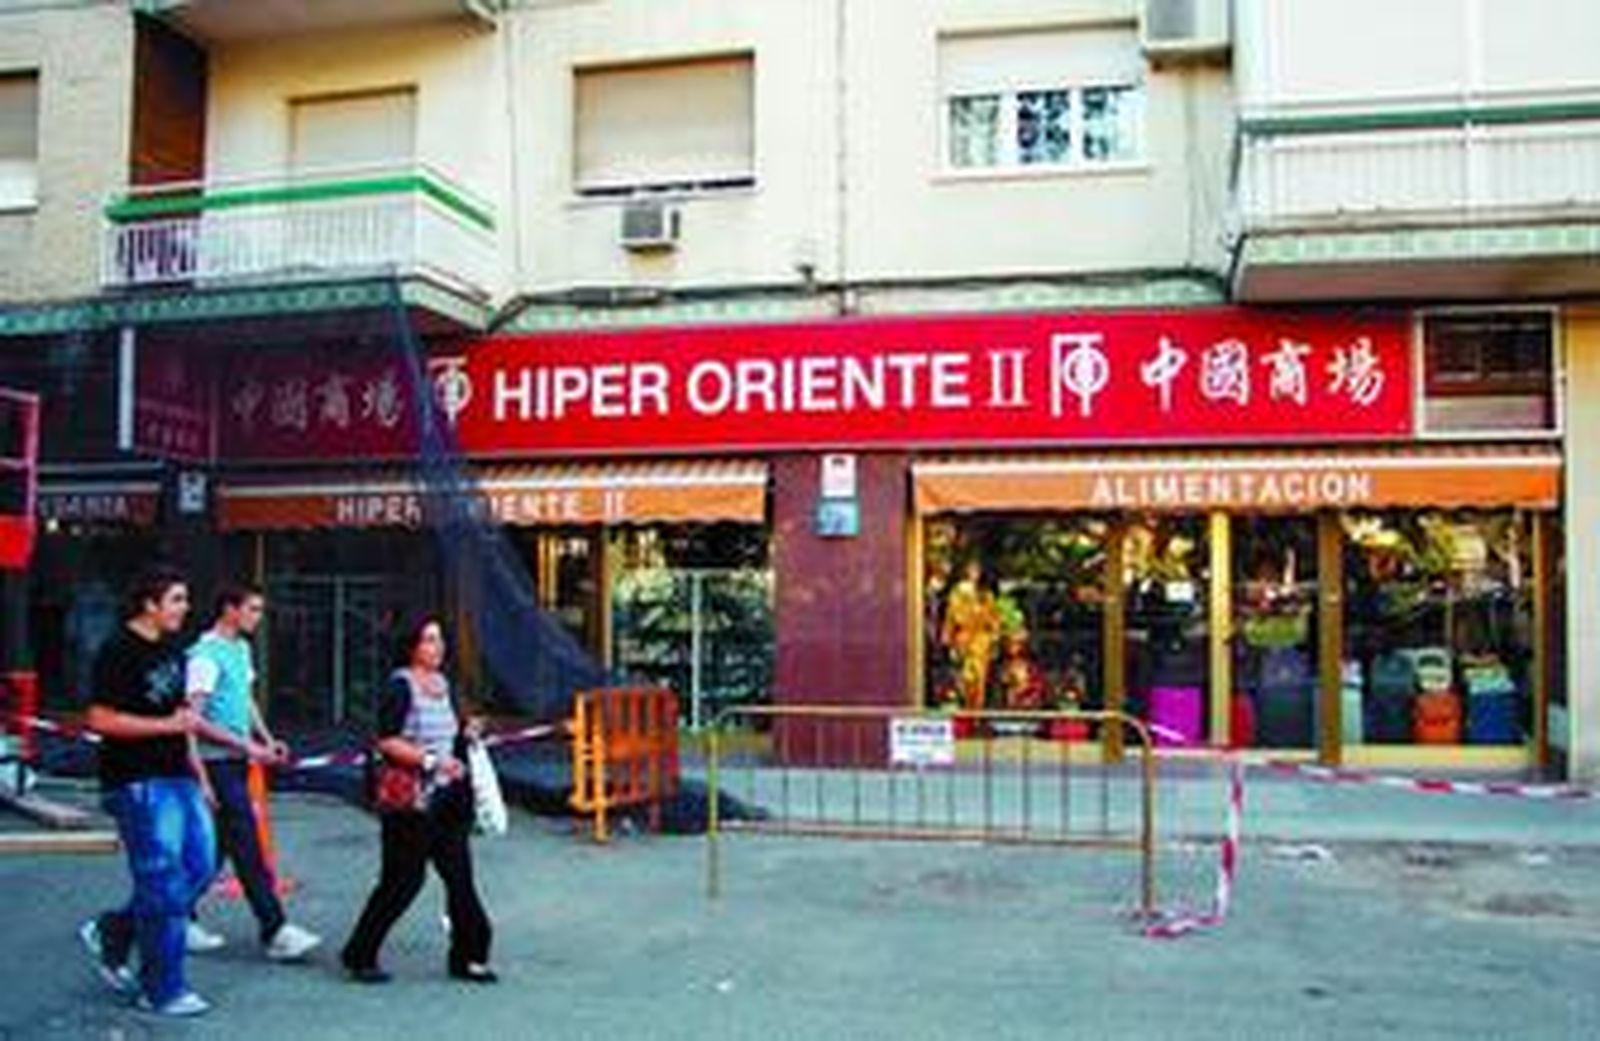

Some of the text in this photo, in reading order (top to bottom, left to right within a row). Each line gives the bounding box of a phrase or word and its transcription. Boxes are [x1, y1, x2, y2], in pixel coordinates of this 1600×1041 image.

[494, 365, 668, 421] HIPER
[686, 352, 971, 414] ORIENTE
[1140, 336, 1386, 412] 中國商場
